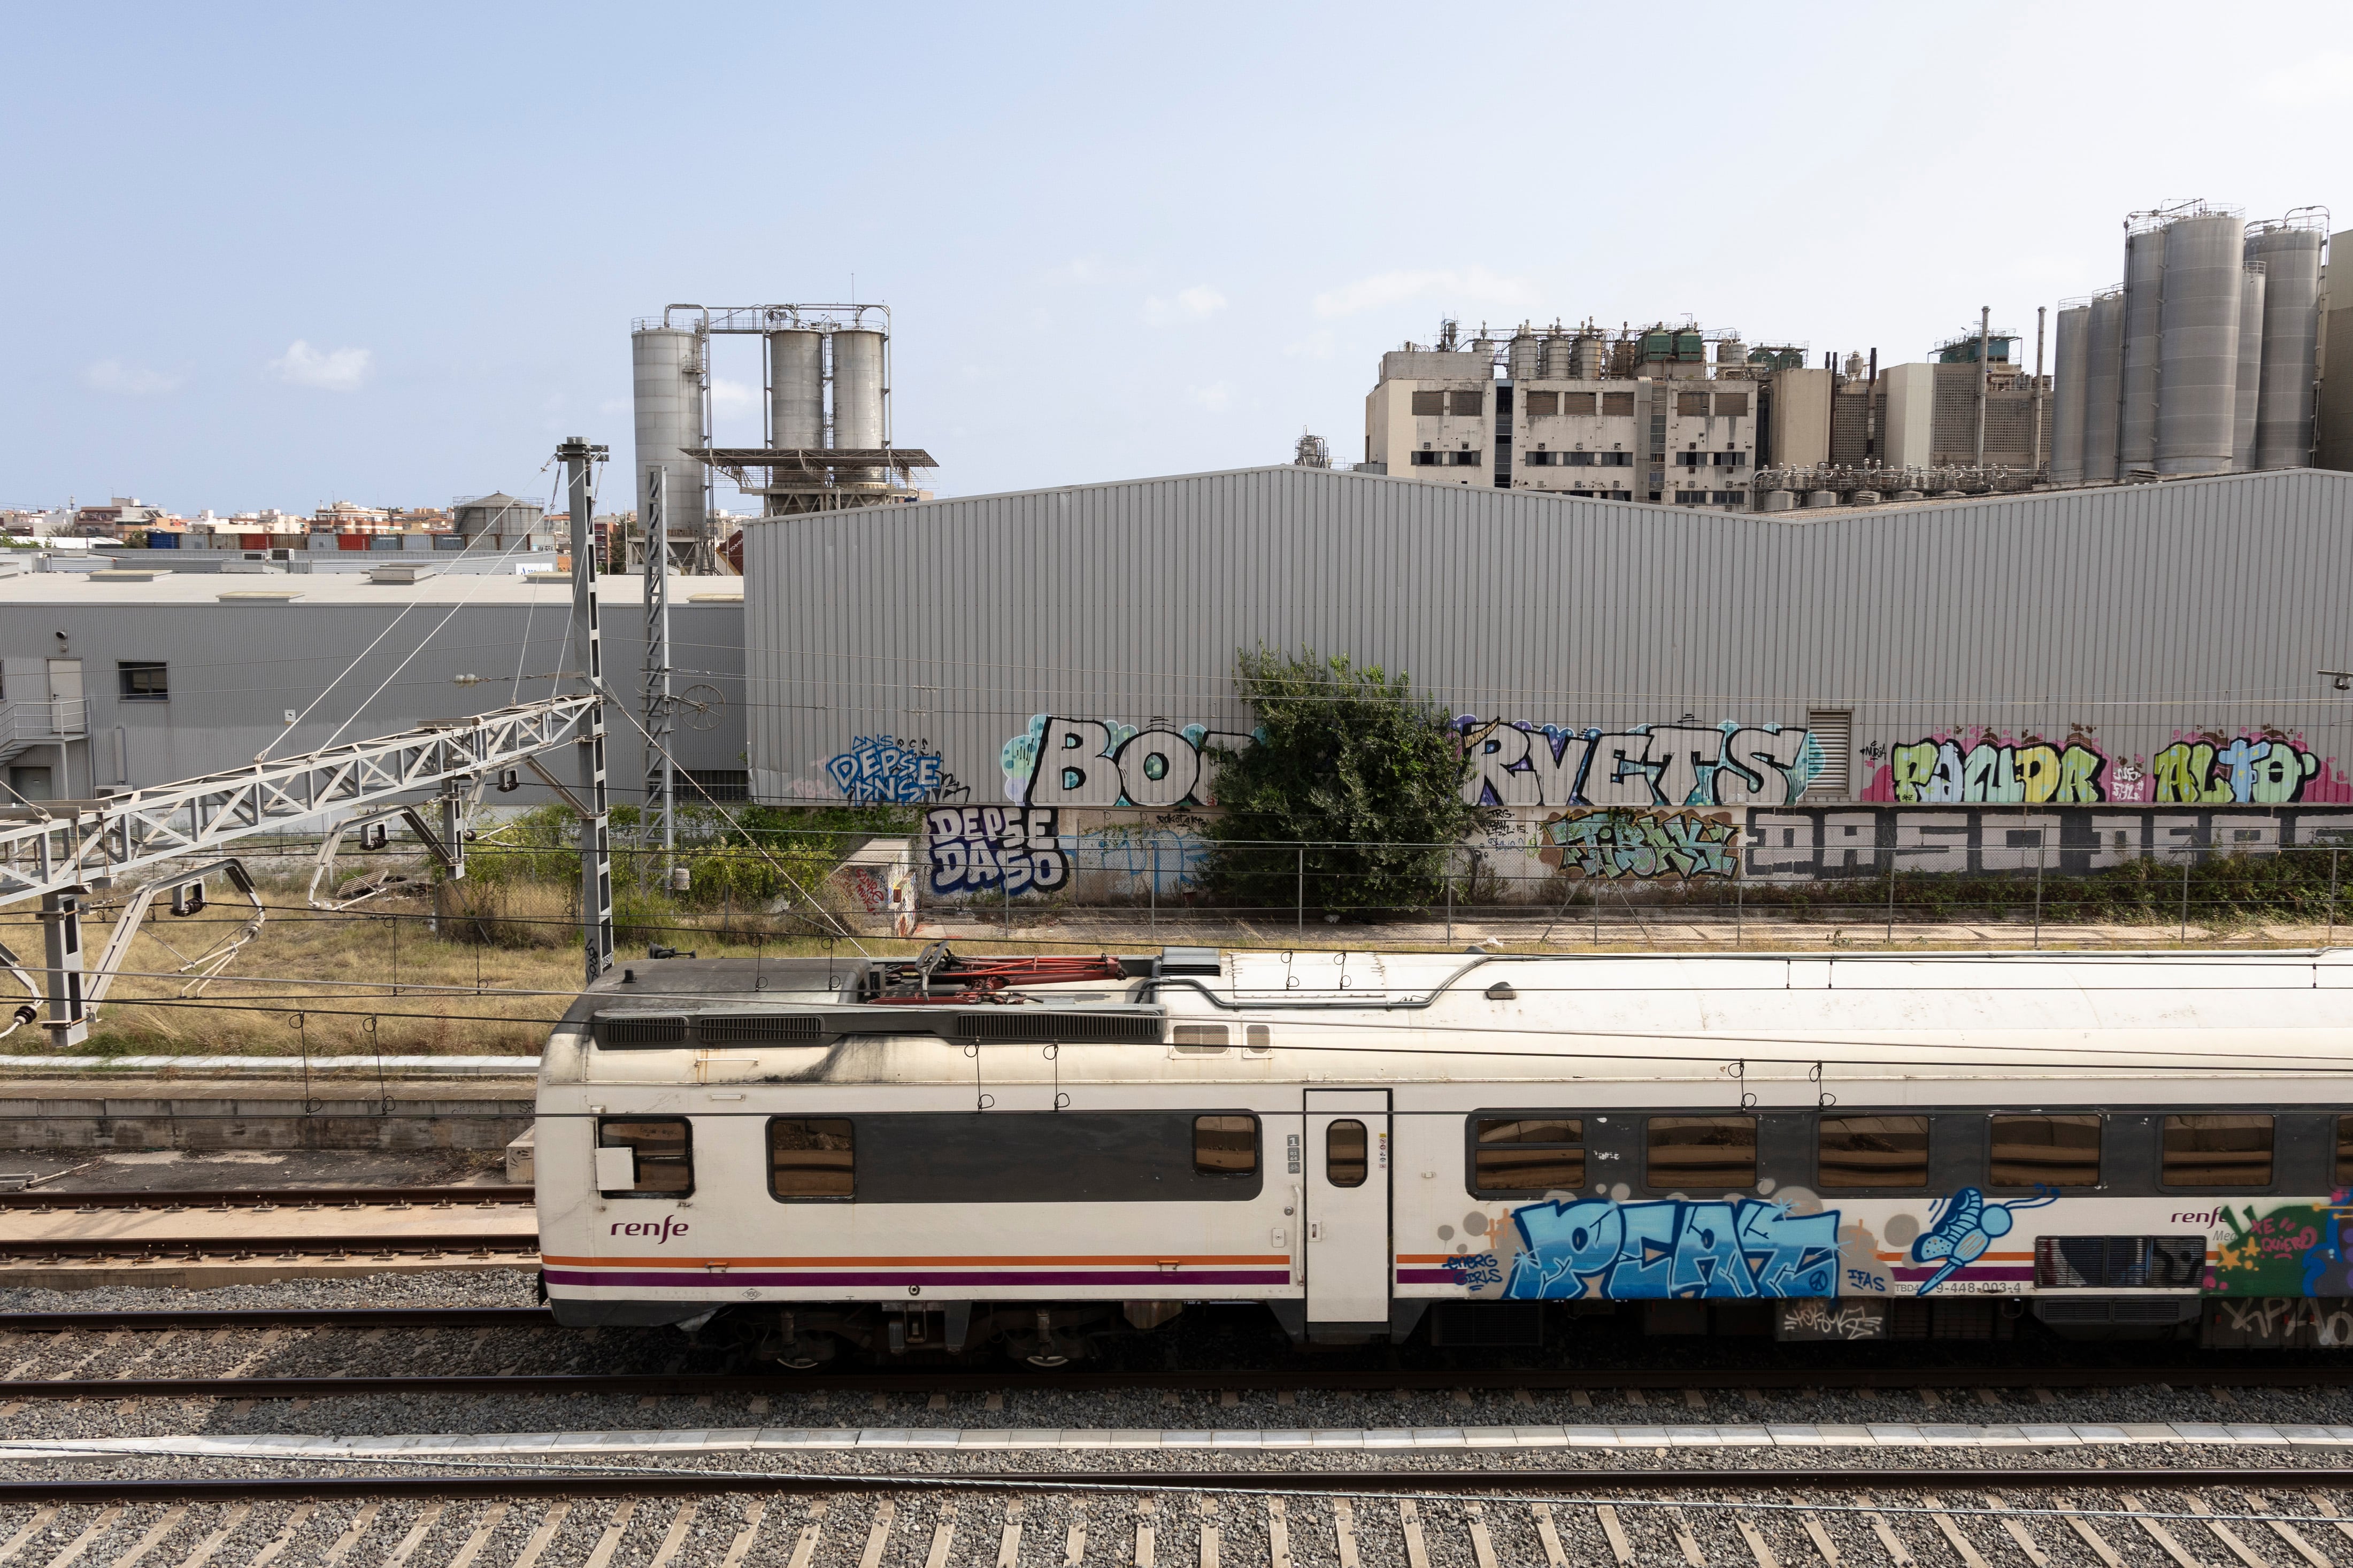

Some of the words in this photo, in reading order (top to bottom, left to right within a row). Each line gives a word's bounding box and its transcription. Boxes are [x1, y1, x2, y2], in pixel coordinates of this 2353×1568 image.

[927, 807, 1059, 850] DEPSE
[929, 841, 1069, 895] DASO
[1289, 1137, 1297, 1146] 1
[610, 1215, 689, 1245] renfe
[1454, 1269, 1503, 1286] GIRLS
